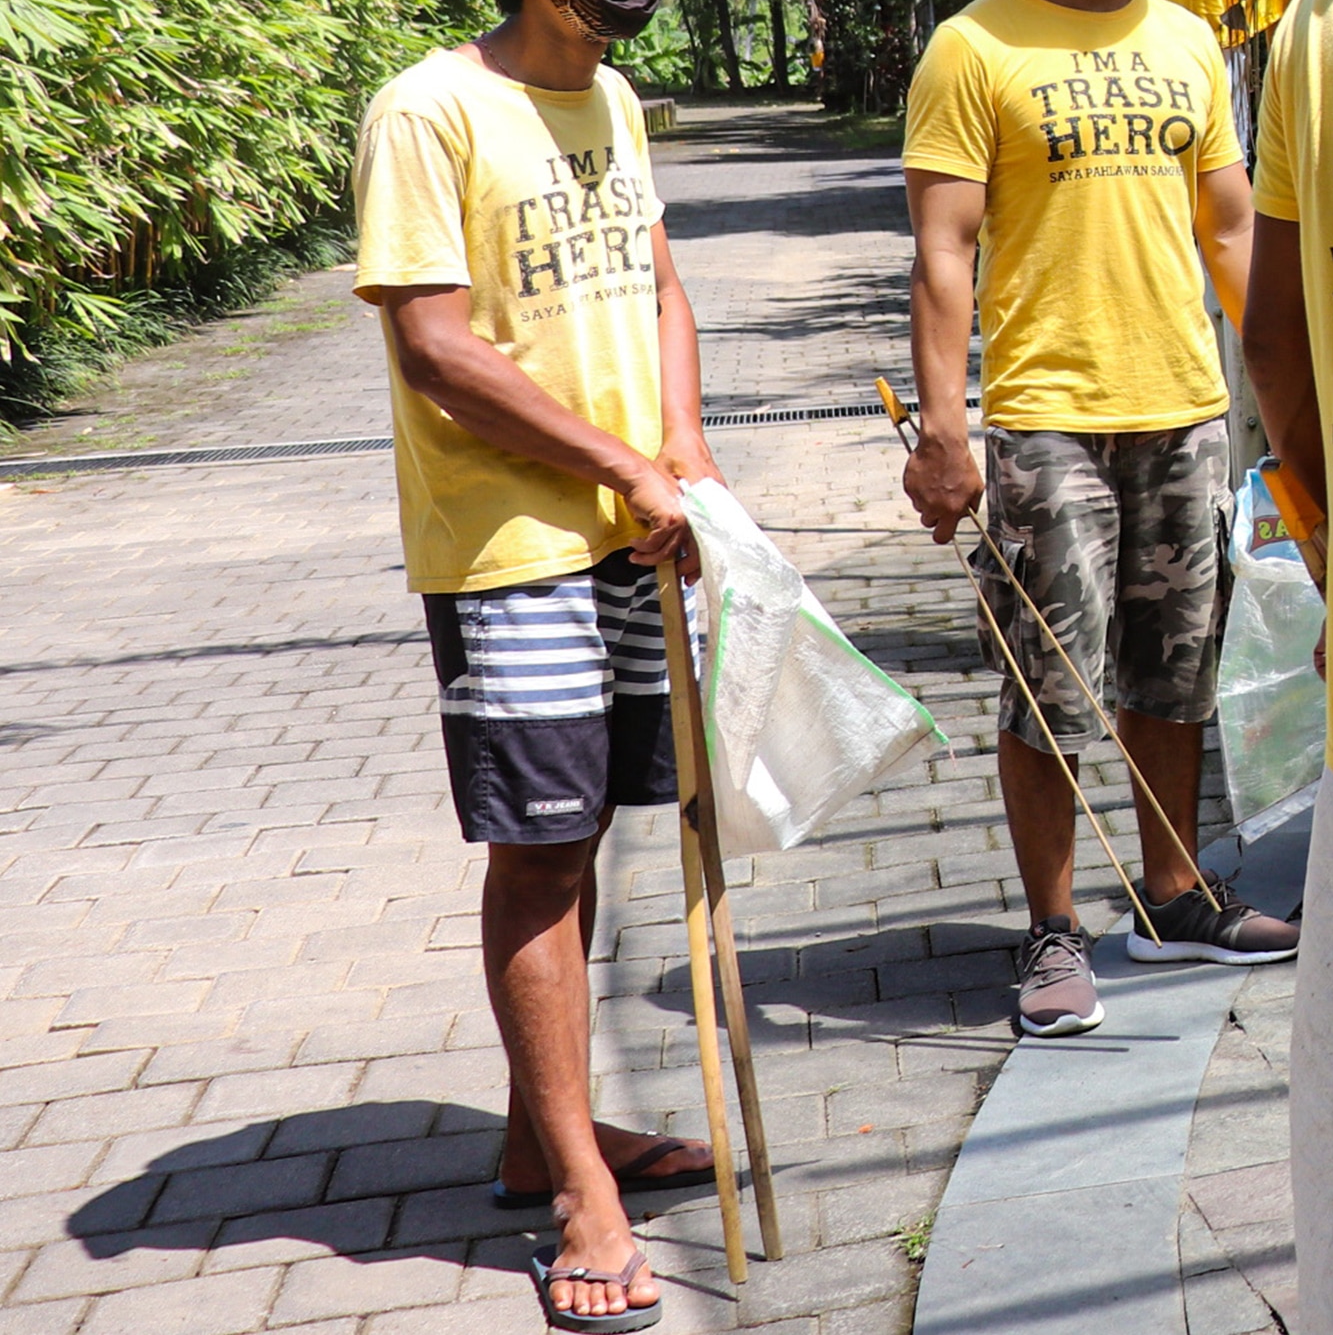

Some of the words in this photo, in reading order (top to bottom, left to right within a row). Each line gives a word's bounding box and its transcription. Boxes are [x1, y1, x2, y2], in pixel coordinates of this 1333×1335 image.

[1070, 51, 1120, 73] I'M
[1131, 52, 1151, 72] A
[1031, 77, 1195, 118] TRASH
[1040, 114, 1195, 163] HERO
[546, 149, 598, 185] I'M
[605, 146, 621, 172] A
[1049, 169, 1084, 184] SAYA
[1086, 166, 1148, 179] PAHLAWAN
[505, 176, 644, 243] TRASH
[520, 303, 567, 323] SAYA
